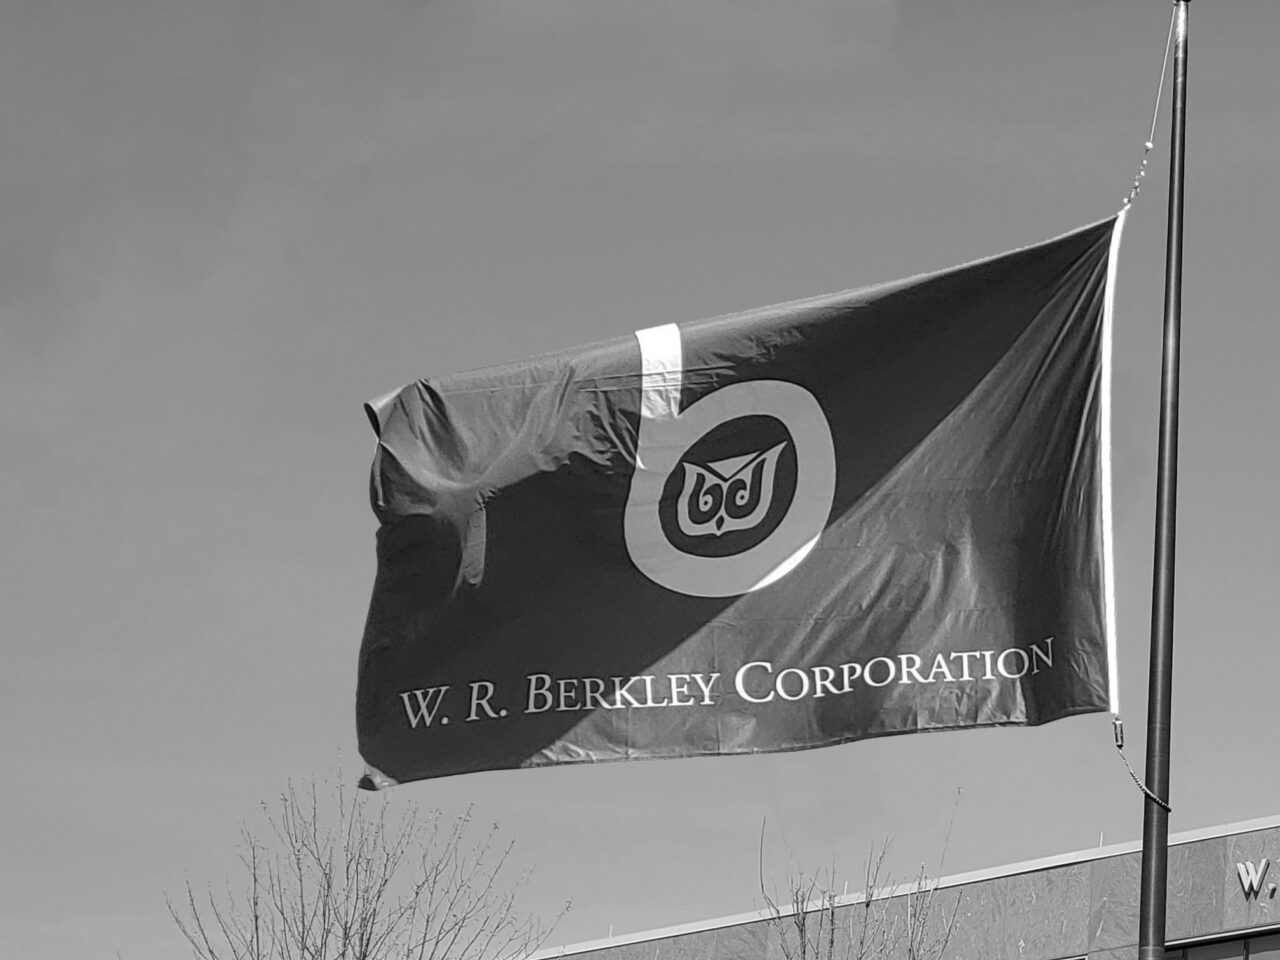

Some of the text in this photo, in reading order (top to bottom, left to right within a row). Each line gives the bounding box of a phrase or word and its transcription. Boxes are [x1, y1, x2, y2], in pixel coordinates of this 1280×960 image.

[400, 637, 1055, 728] W. R. BERKLEY CORPORATION
[1237, 858, 1277, 900] W.
